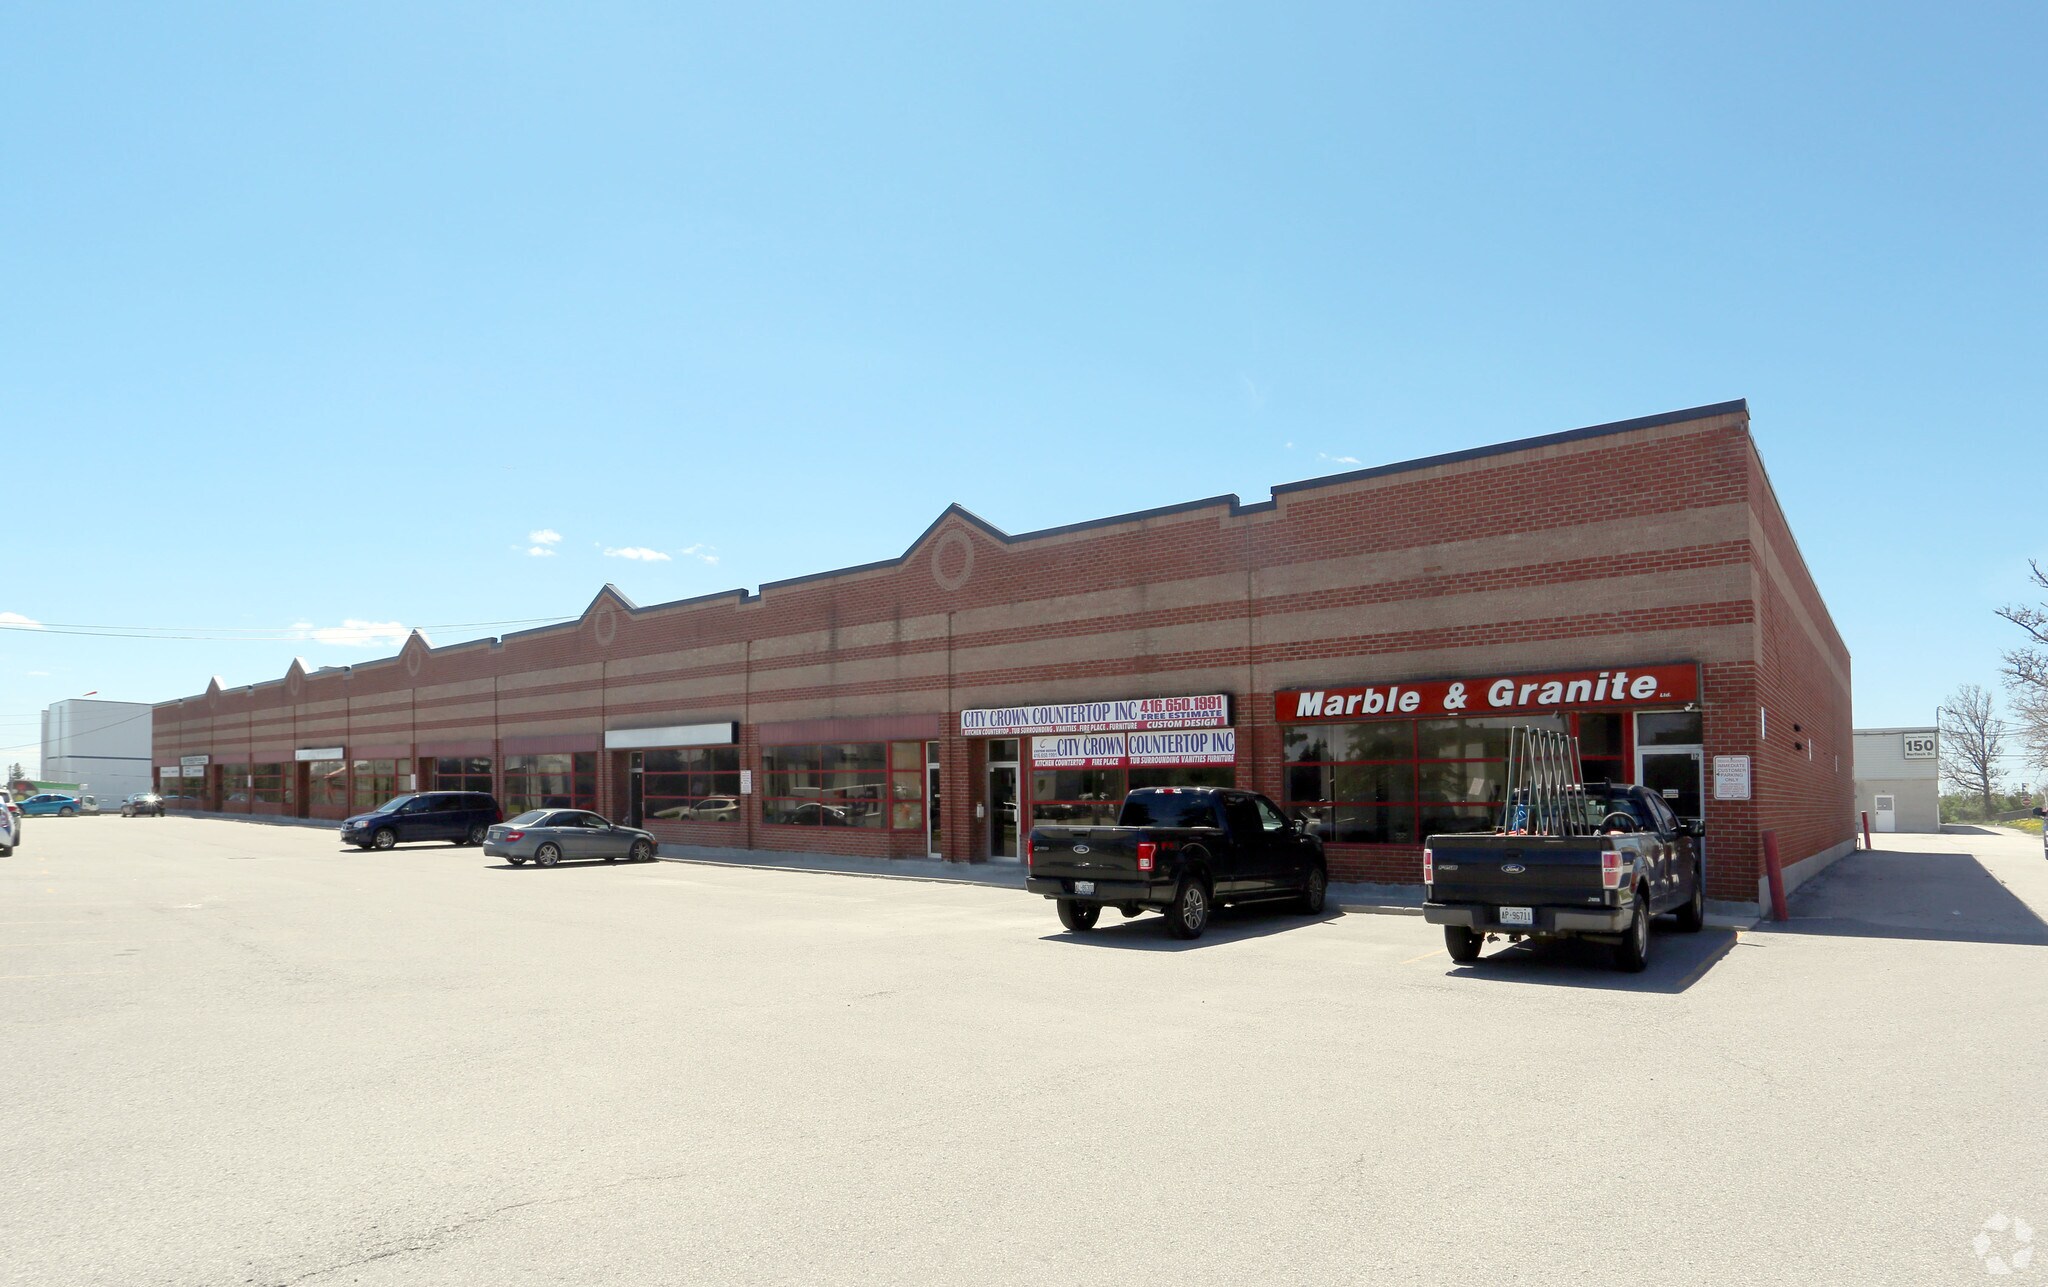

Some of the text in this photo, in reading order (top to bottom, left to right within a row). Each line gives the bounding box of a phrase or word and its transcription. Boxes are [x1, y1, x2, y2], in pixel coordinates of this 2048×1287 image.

[1296, 671, 1658, 717] Marble & Granite
[1140, 695, 1222, 713] 416.650.1991
[964, 701, 1138, 728] CITY CROWN COUNTERTOP INC
[1141, 710, 1222, 720] FREE ESTIMATE
[981, 728, 1009, 736] COUNTERTOP
[1011, 727, 1020, 735] TUB
[1020, 726, 1053, 735] SURROUNDING
[1055, 725, 1077, 733] VANITIES
[1080, 724, 1090, 732] FIRE
[1090, 723, 1106, 731] PLACE
[1109, 722, 1138, 730] FURNITURE
[1146, 718, 1218, 729] CUSTOM DESIGN
[1057, 736, 1124, 757] CITY CROWN
[1129, 731, 1235, 754] COUNTERTOP INC
[1906, 740, 1934, 751] 150
[1034, 757, 1119, 767] KITCHEN COUNTERTOP FIRE PLACE
[1130, 754, 1234, 764] TUB SURROUNDING VANITIES FURNITURE
